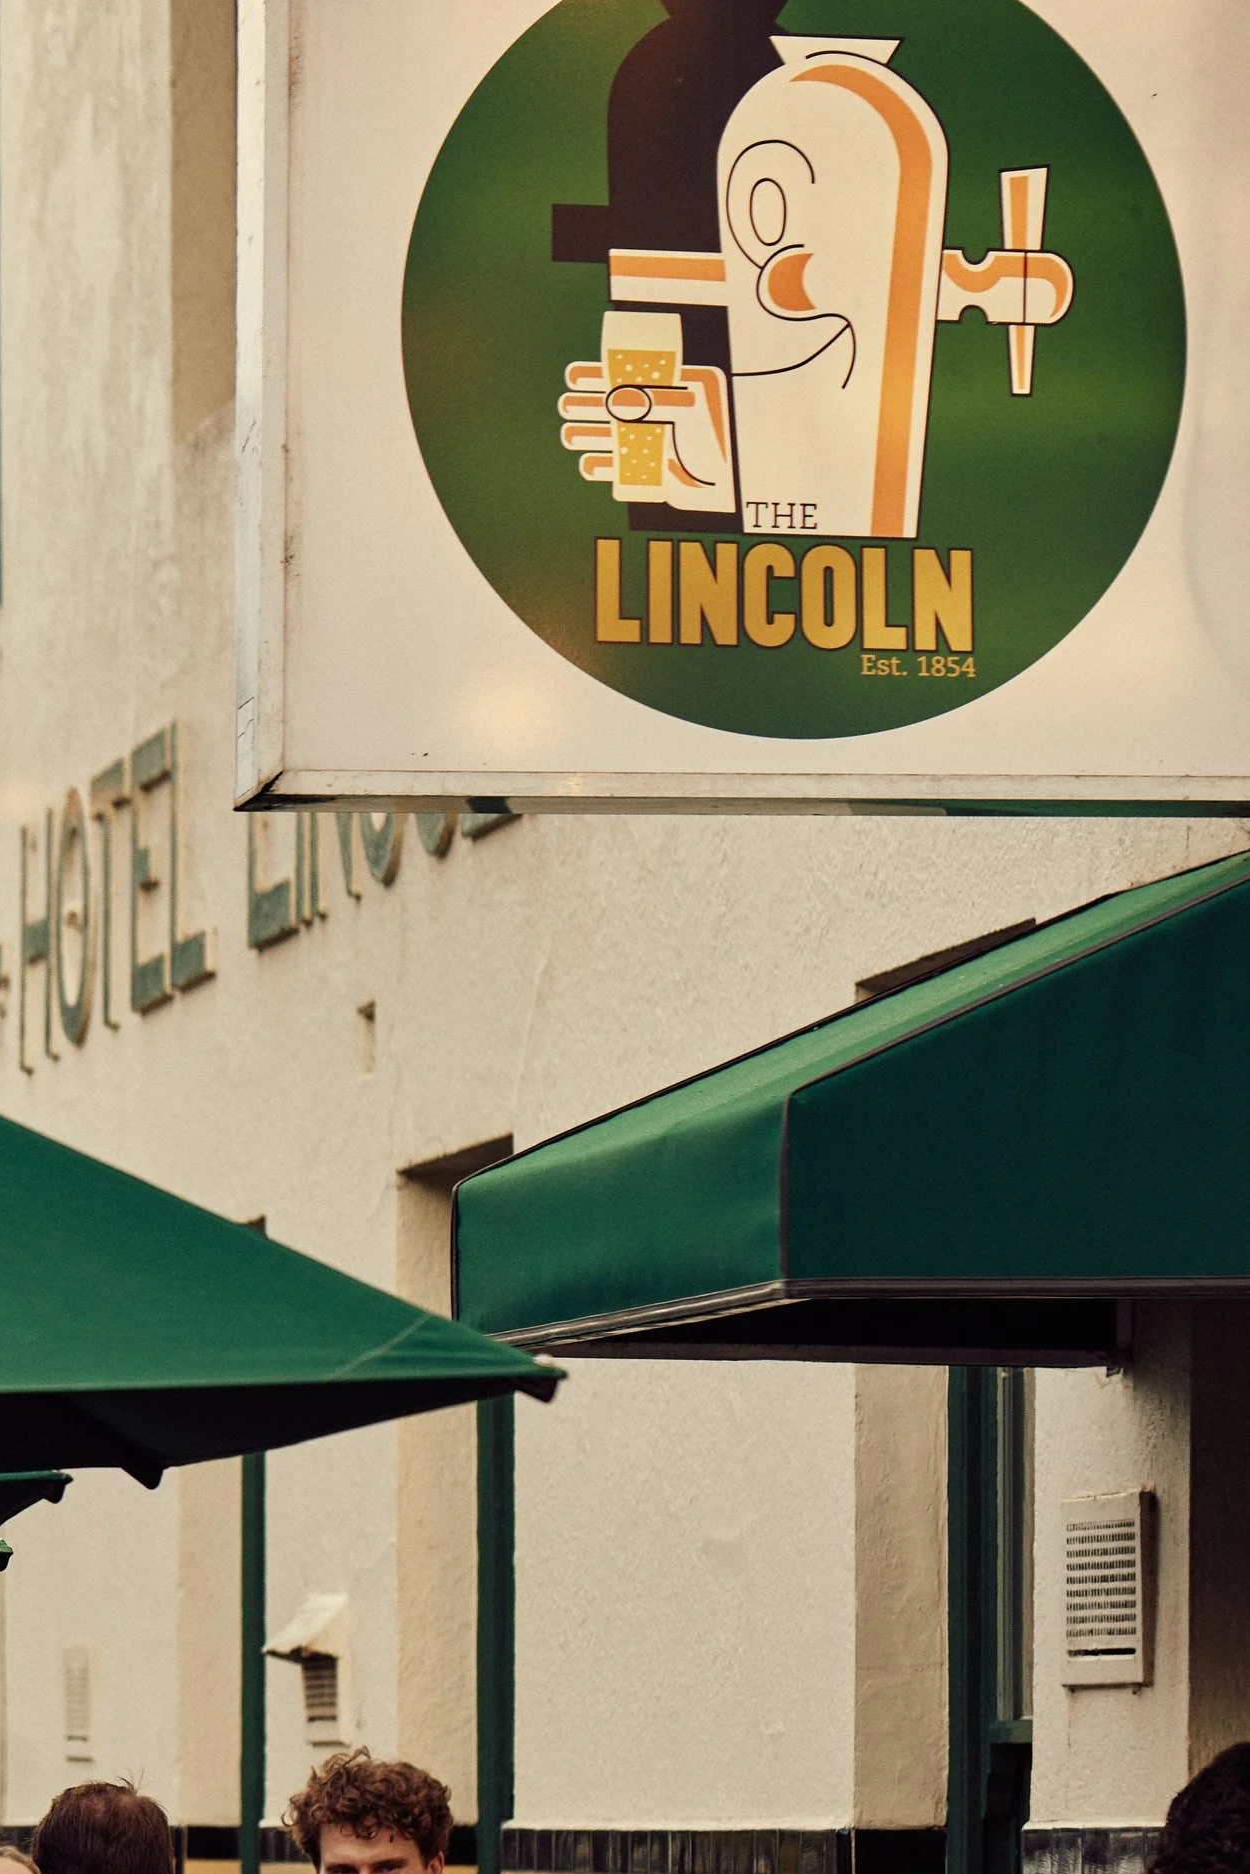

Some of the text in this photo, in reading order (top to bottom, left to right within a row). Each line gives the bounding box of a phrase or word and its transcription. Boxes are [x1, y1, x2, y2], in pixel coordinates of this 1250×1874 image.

[745, 501, 818, 530] THE
[595, 536, 975, 654] LINCOLN
[860, 653, 976, 678] Est. 1854
[19, 721, 210, 1074] HOTEL
